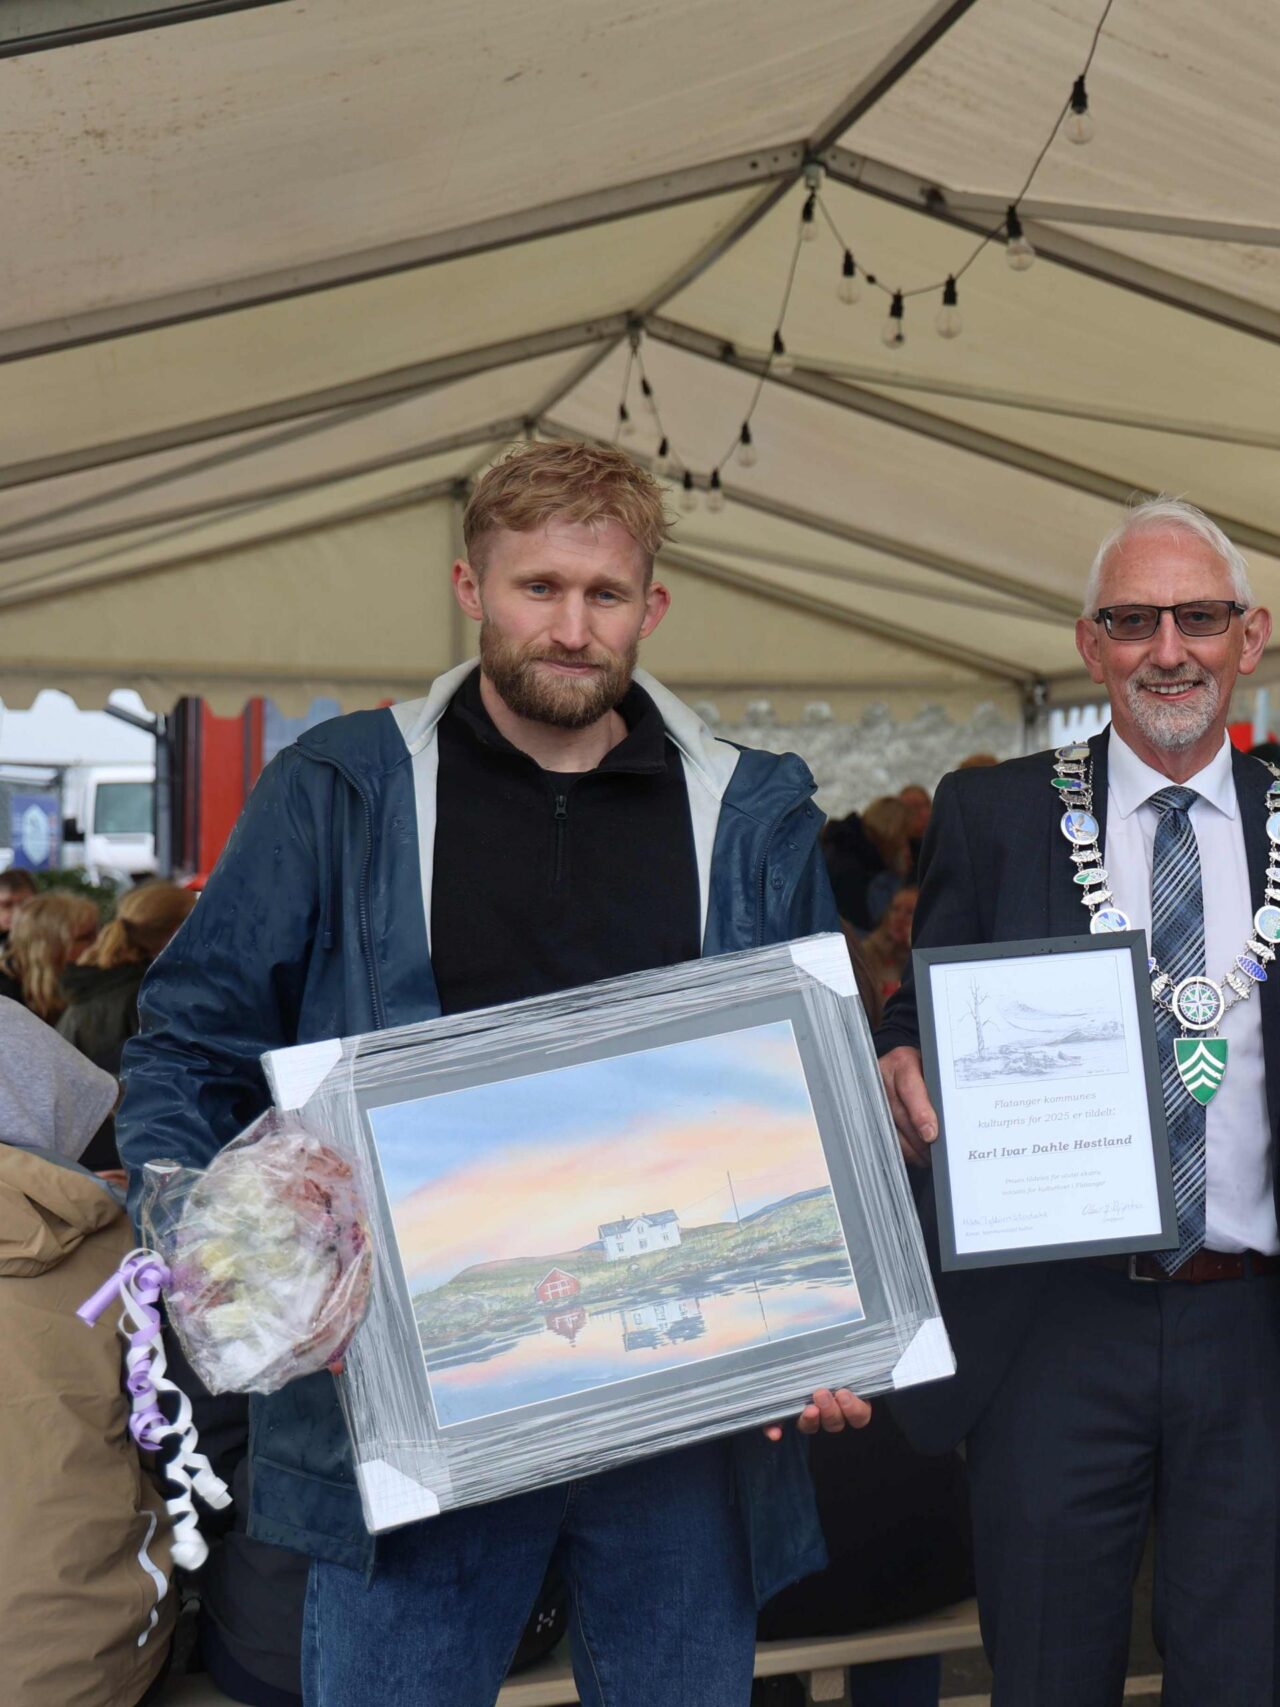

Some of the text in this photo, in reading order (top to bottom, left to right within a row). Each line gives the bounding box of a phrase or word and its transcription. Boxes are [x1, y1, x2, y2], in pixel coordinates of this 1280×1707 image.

[994, 1092, 1097, 1109] Flatanger kommunes
[978, 1116, 1026, 1129] kulturpris
[1028, 1115, 1042, 1127] for
[1044, 1111, 1070, 1122] 2025
[1072, 1112, 1083, 1120] er
[968, 1134, 1132, 1160] Karl Ivar Dahle Høstland
